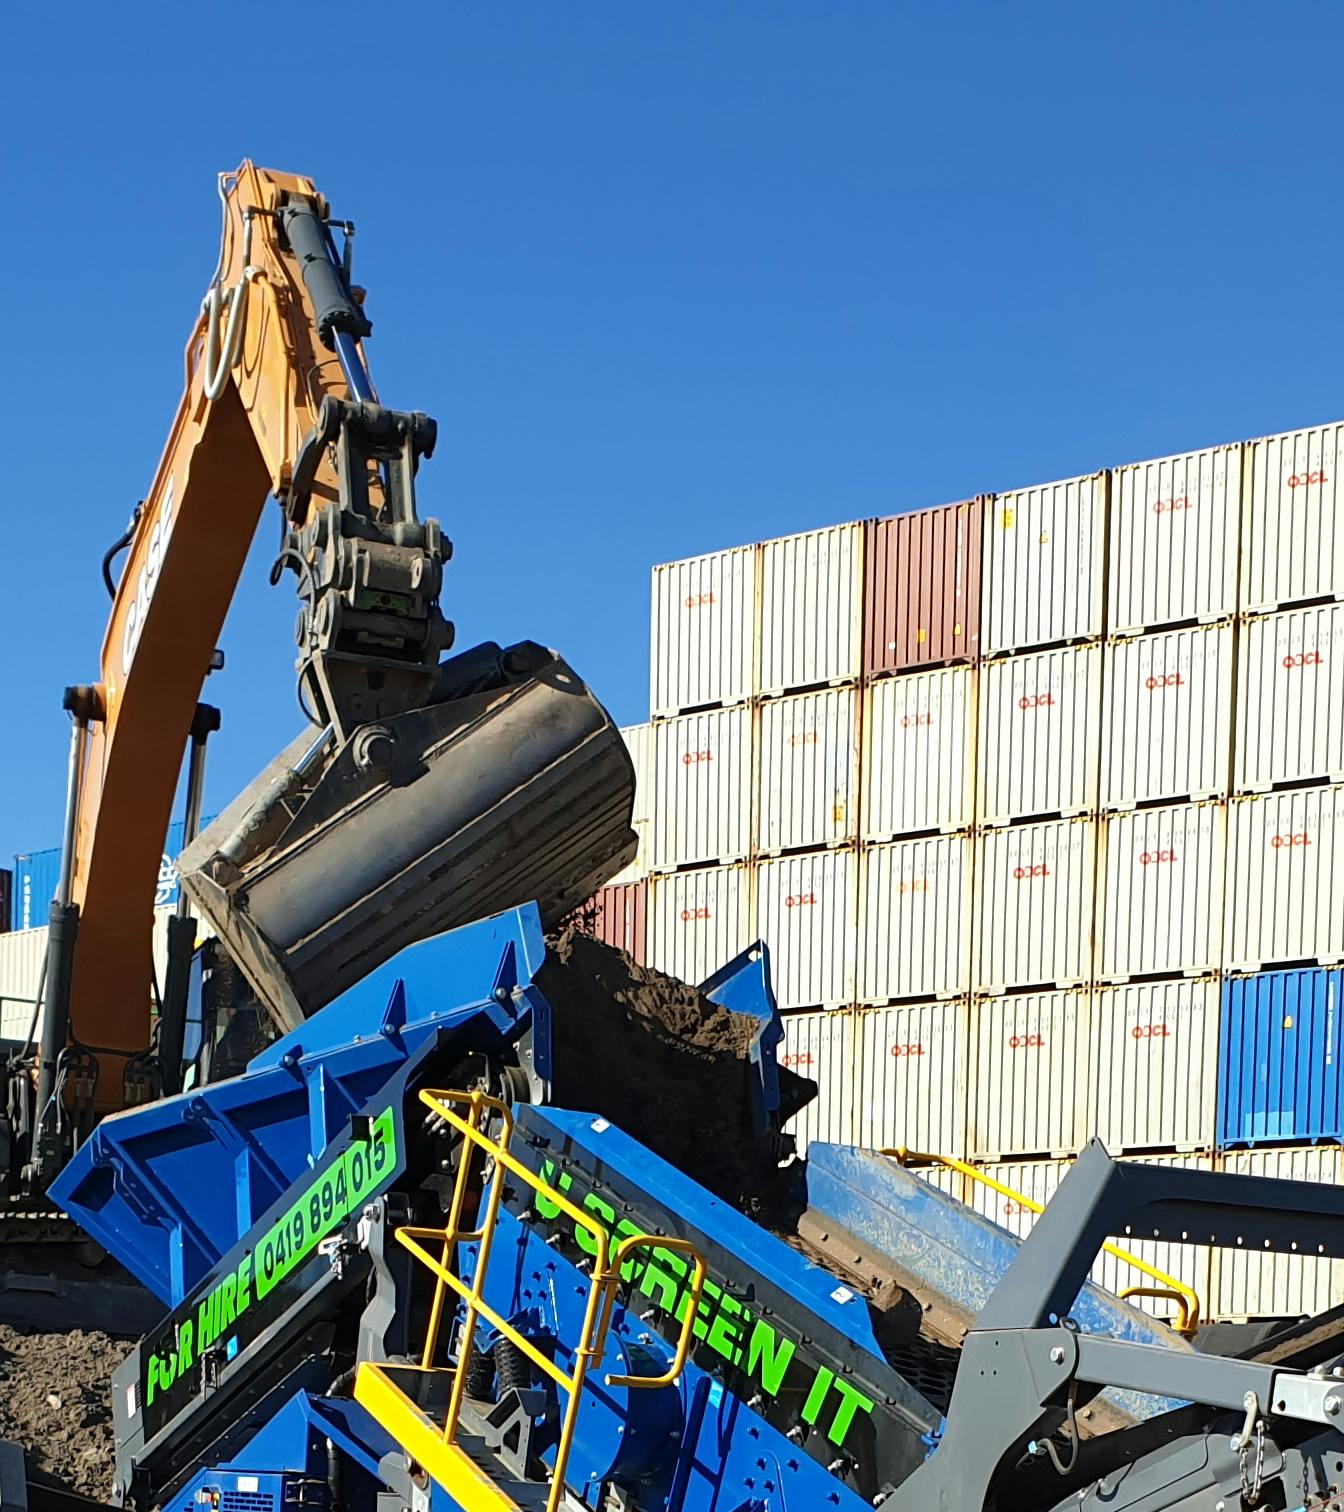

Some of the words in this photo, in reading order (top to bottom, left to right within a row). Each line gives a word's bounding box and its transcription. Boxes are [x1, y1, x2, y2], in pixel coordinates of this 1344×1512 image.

[1288, 470, 1327, 489] OOCL
[1153, 496, 1192, 514] OOCL
[1283, 650, 1323, 669] OOCL
[1146, 673, 1184, 689] OOCL
[1018, 693, 1055, 710] OOCL
[901, 713, 934, 729] OOCL
[683, 750, 713, 767] OOCL
[1272, 833, 1312, 849] OOCL
[1140, 848, 1176, 865] OOCL
[1013, 864, 1050, 880] OOCL
[785, 893, 815, 908] OOCL
[680, 905, 711, 923] OOCL
[1132, 1024, 1169, 1040] OOCL
[892, 1043, 924, 1057] OOCL
[1009, 1033, 1044, 1051] OOCL
[782, 1052, 814, 1067] OOCL
[146, 1316, 196, 1407] FOR
[197, 1252, 253, 1356] HIRE
[262, 1210, 306, 1281] 0419
[308, 1168, 347, 1236] 894
[351, 1124, 388, 1193] 015
[573, 1192, 796, 1397] SCREEN
[800, 1365, 875, 1448] IT
